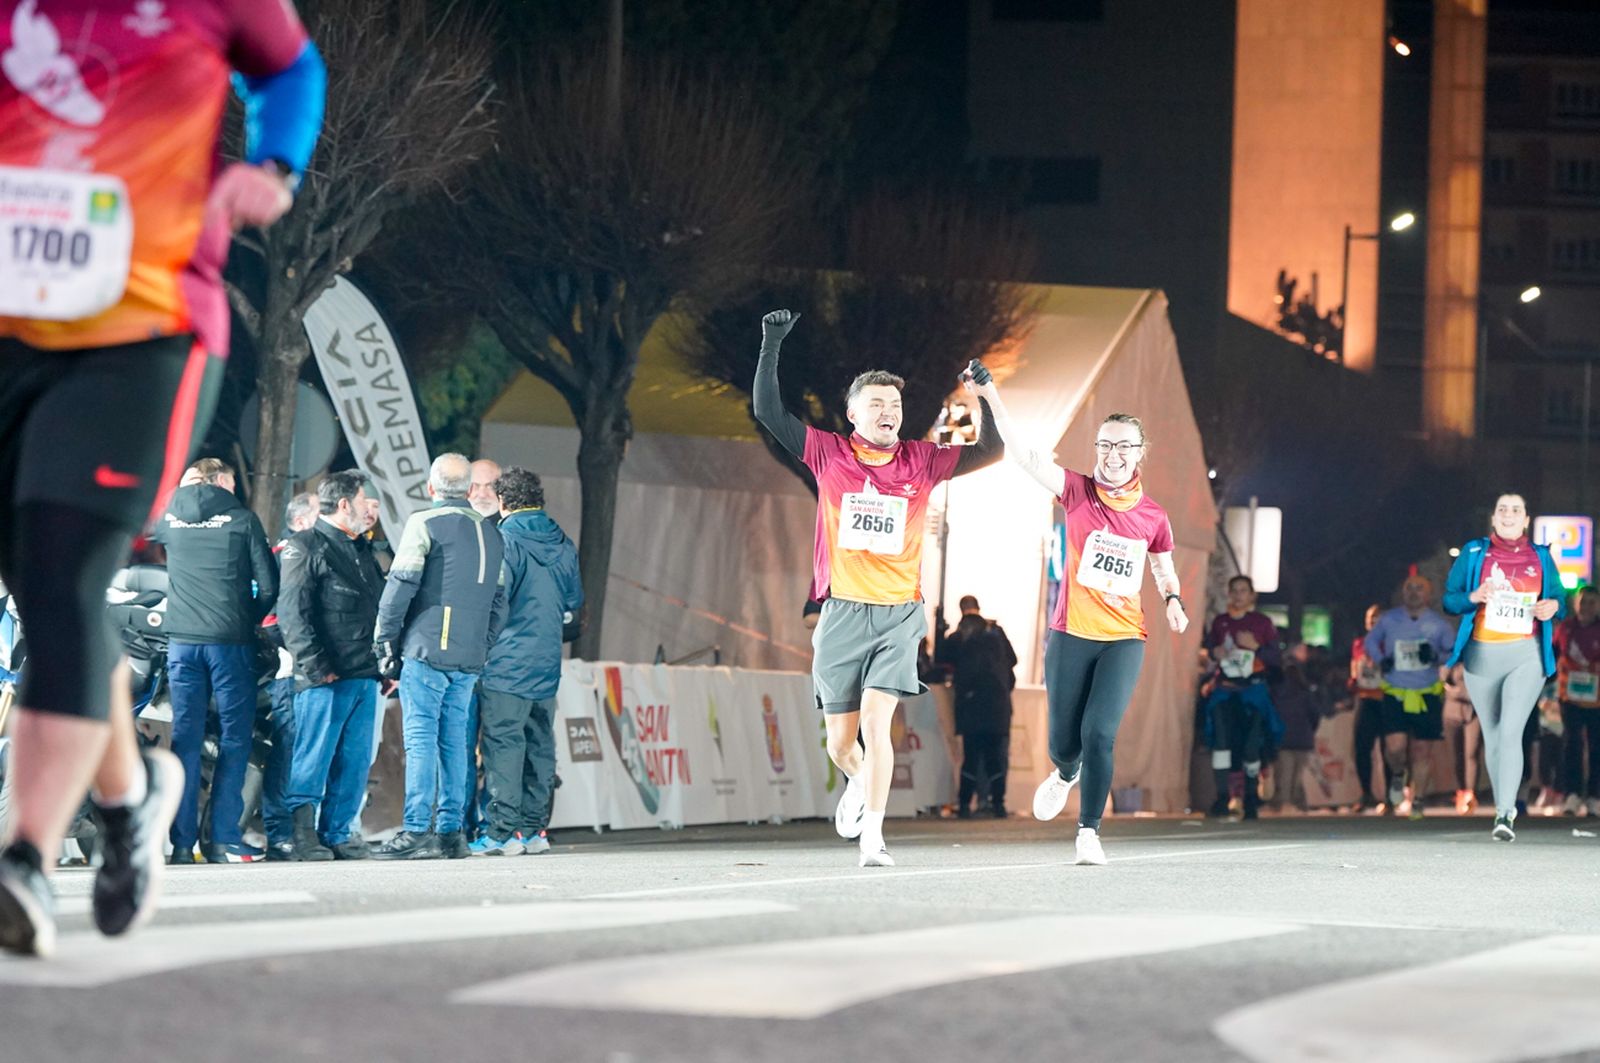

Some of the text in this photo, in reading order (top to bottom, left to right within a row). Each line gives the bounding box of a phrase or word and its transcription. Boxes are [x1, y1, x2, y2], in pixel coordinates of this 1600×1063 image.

[12, 225, 91, 268] 1700
[849, 504, 863, 512] SAN
[852, 513, 894, 534] 2656
[1093, 544, 1105, 552] SAN
[1093, 552, 1134, 577] 2655
[1496, 605, 1525, 618] 3214
[636, 704, 670, 742] SAN
